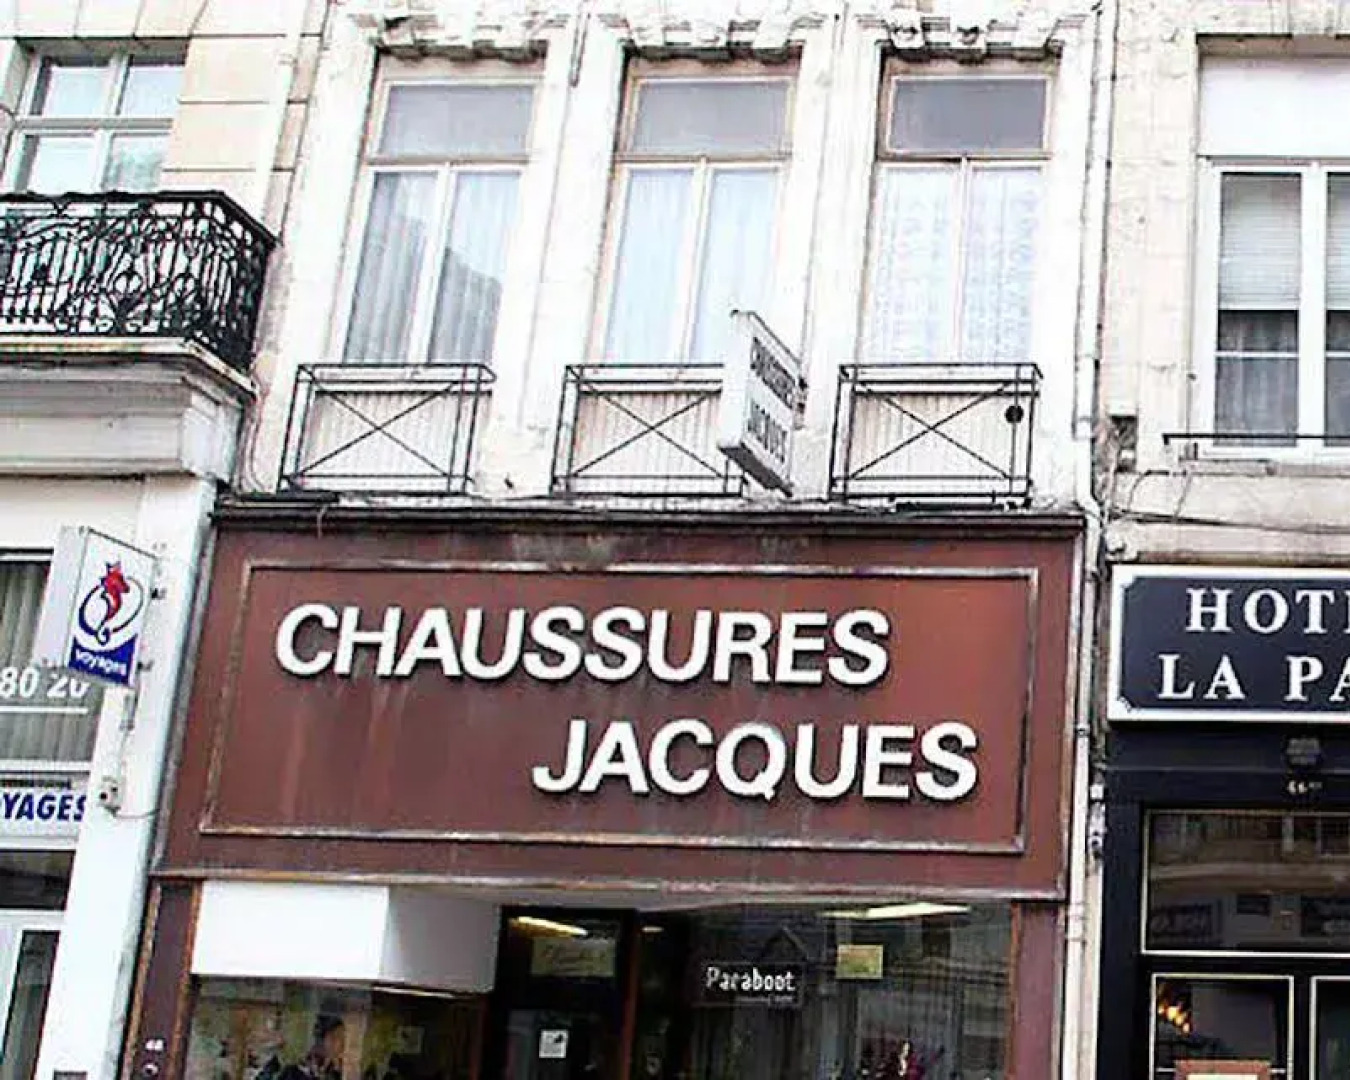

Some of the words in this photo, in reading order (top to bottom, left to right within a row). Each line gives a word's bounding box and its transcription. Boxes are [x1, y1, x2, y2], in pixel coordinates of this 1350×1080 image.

[275, 603, 891, 685] CHAUSSURES
[0, 666, 40, 698] 80
[1157, 653, 1246, 700] LA
[530, 718, 980, 800] JACQUES
[706, 966, 796, 992] Paraboot
